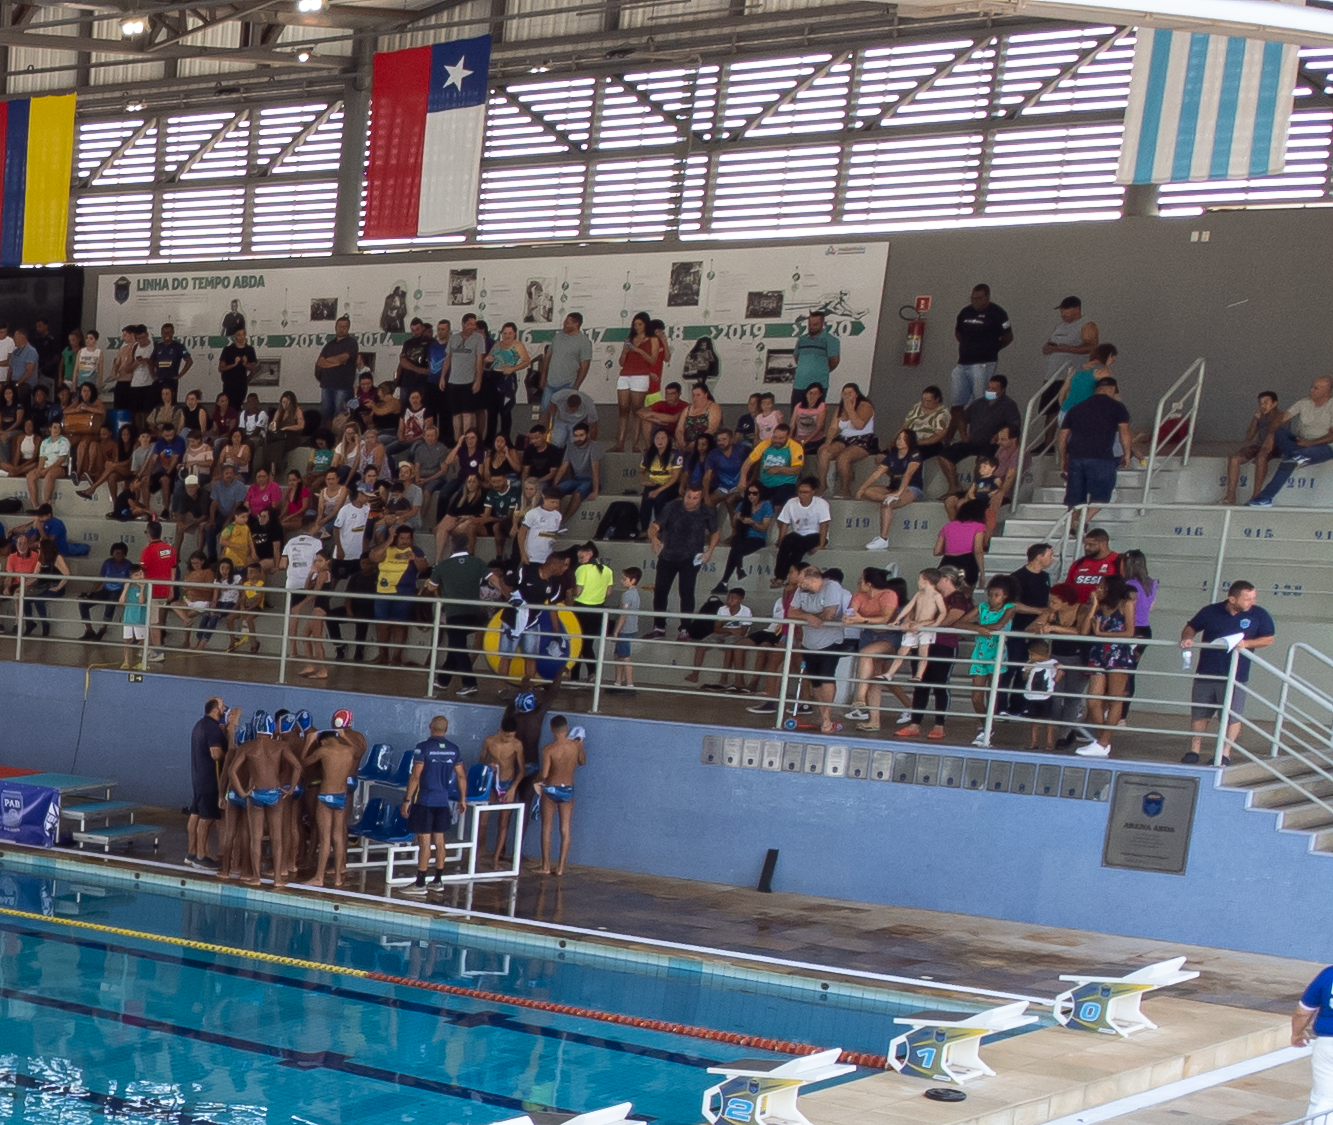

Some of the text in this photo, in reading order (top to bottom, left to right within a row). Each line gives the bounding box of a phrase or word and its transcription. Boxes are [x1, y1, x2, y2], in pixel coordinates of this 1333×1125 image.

[136, 275, 266, 292] LINHA DO TEMPO ABDA
[719, 322, 766, 341] 2019
[291, 333, 328, 348] 2013
[844, 517, 871, 529] 219
[1075, 575, 1103, 585] SESI
[3, 798, 21, 809] PAB
[1079, 1001, 1102, 1023] 0
[916, 1047, 937, 1069] 1
[724, 1096, 755, 1123] 2
